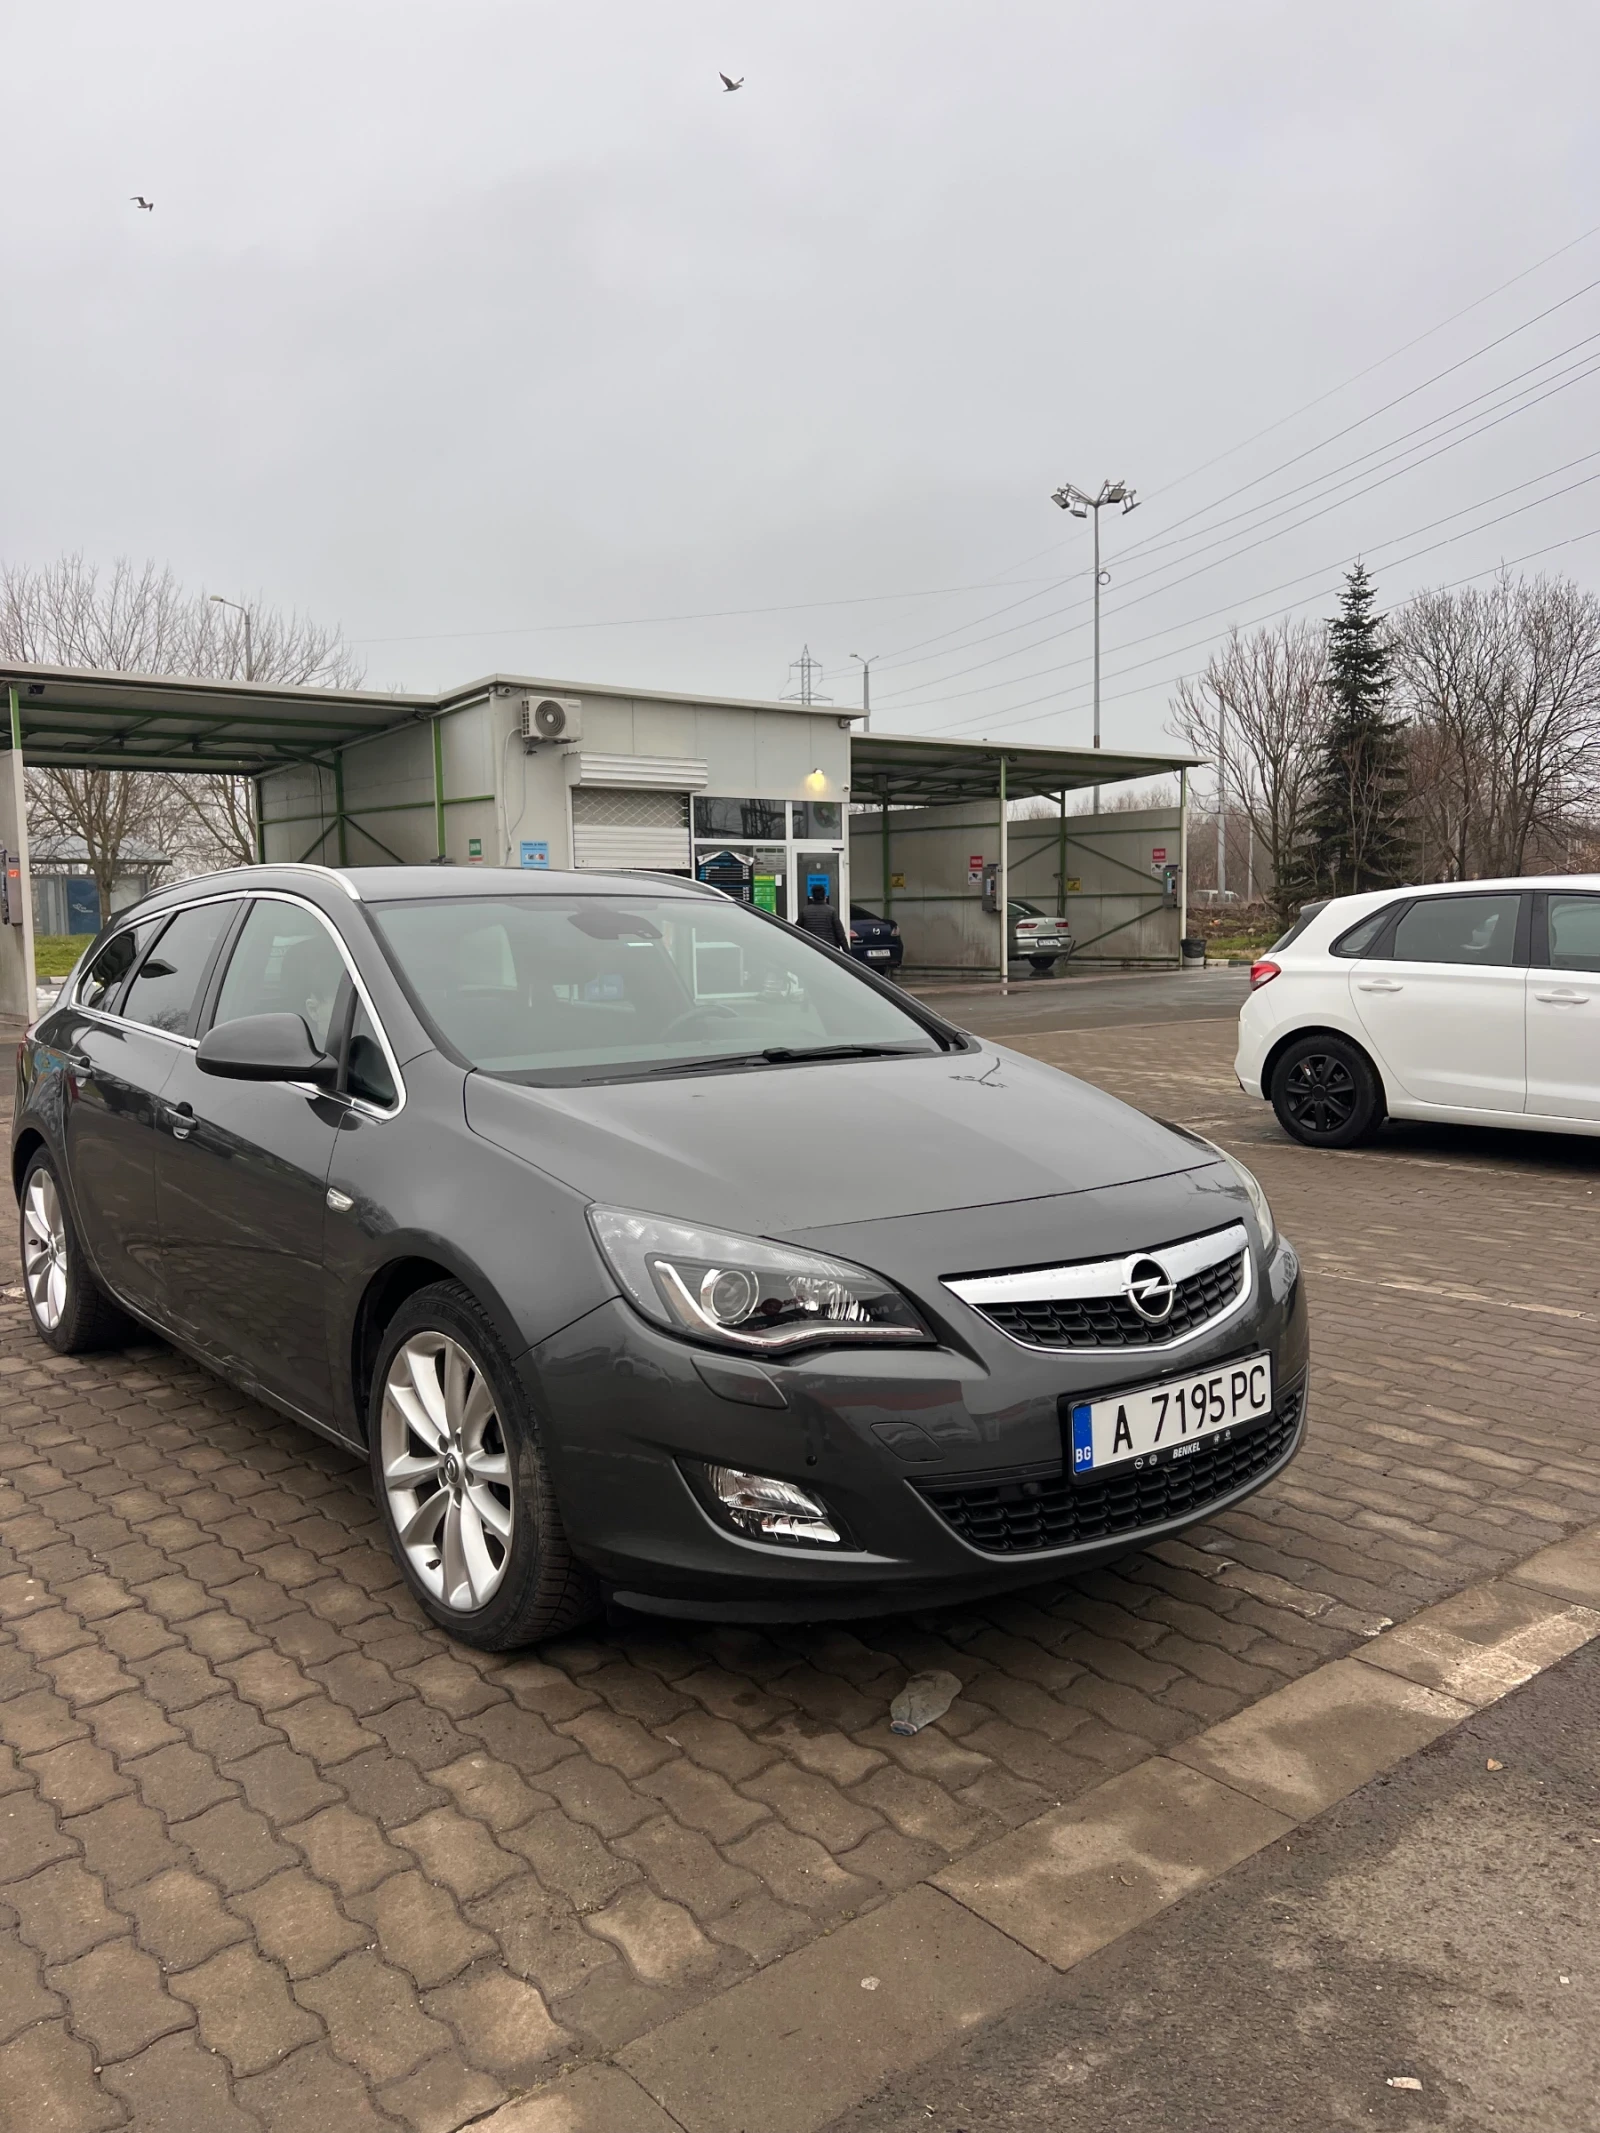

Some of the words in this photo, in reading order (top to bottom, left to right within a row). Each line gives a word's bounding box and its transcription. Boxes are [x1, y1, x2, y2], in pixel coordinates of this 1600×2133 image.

[1112, 1404, 1133, 1454] A
[1075, 1445, 1092, 1463] BG
[1172, 1441, 1201, 1459] BENKEL
